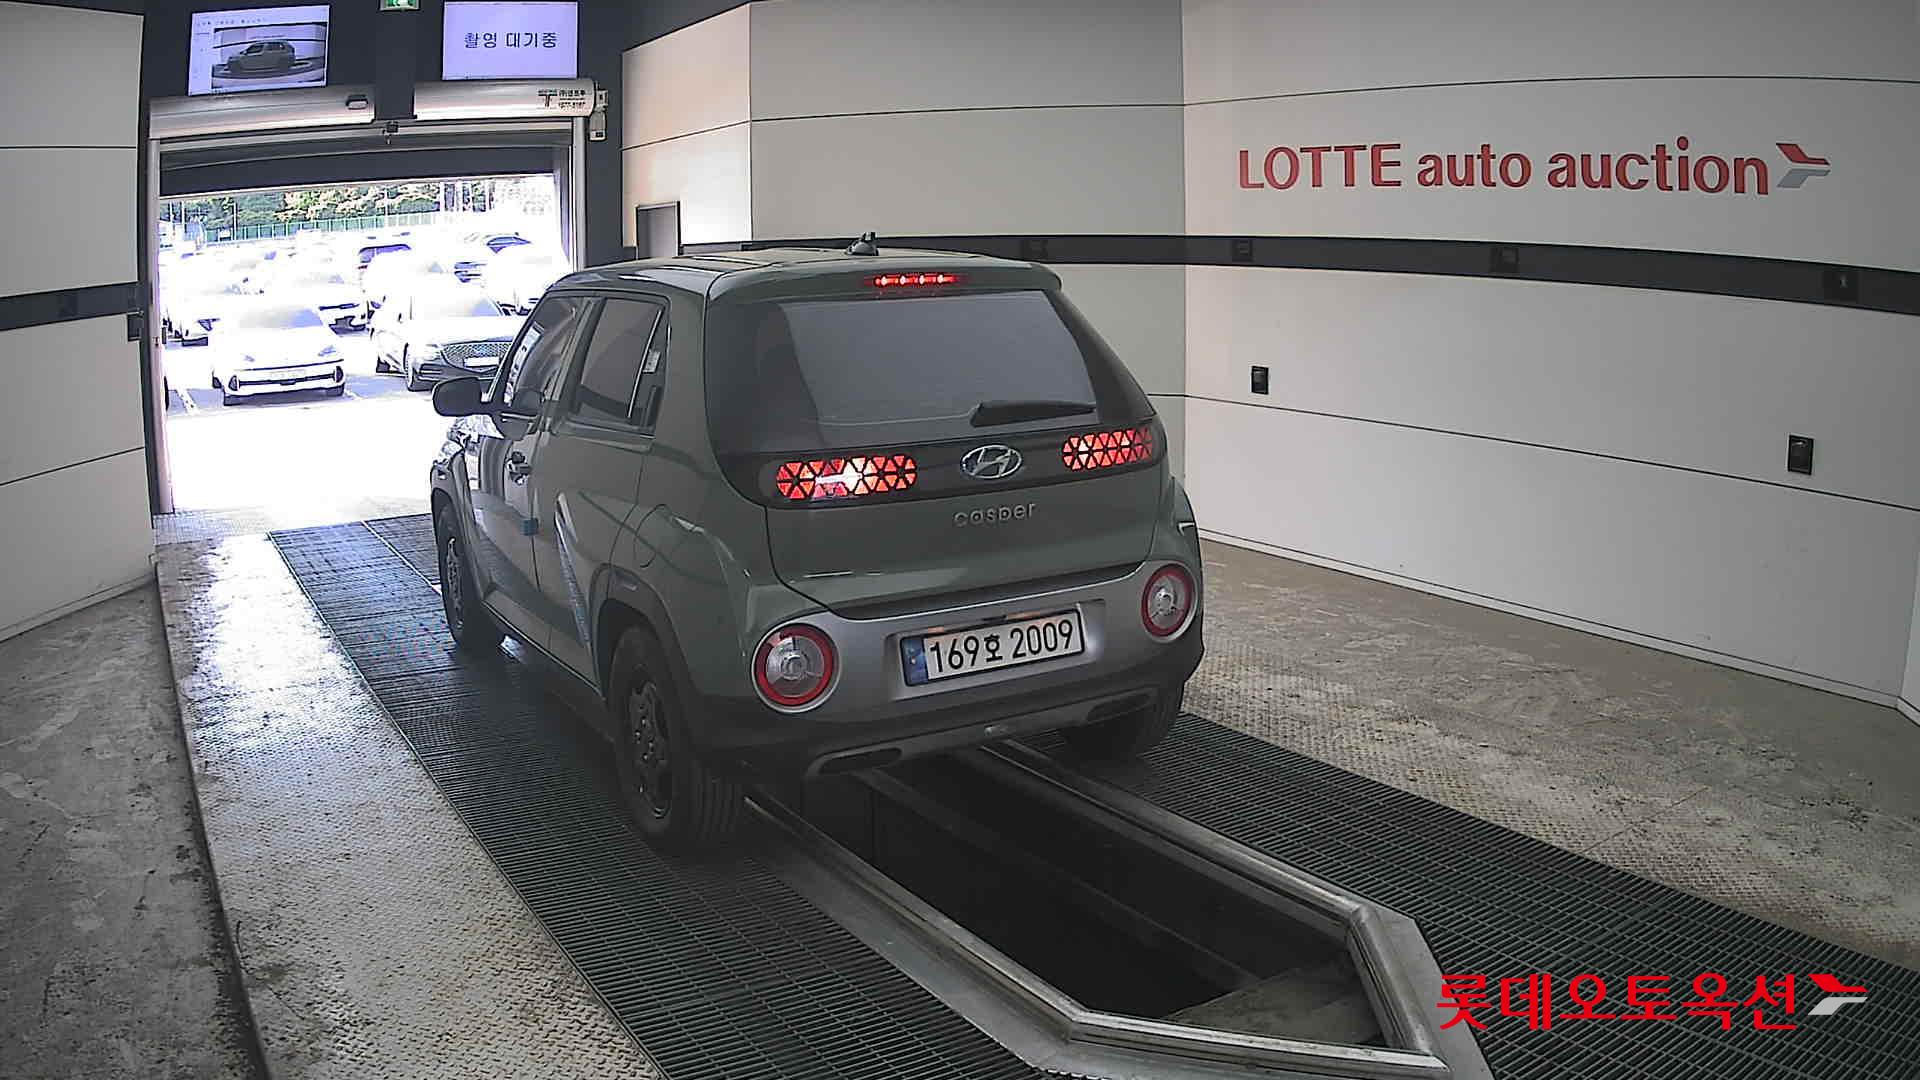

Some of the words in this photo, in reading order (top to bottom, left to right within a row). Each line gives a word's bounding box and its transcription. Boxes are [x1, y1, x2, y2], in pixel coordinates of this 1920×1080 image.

[464, 32, 497, 48] 촬영
[505, 32, 557, 48] 대기중
[1239, 143, 1401, 190] LOTTE
[1418, 143, 1532, 188] auto
[1547, 136, 1769, 195] auction
[954, 502, 1036, 527] casper
[929, 634, 1003, 673] 169호
[1010, 620, 1073, 659] 2009
